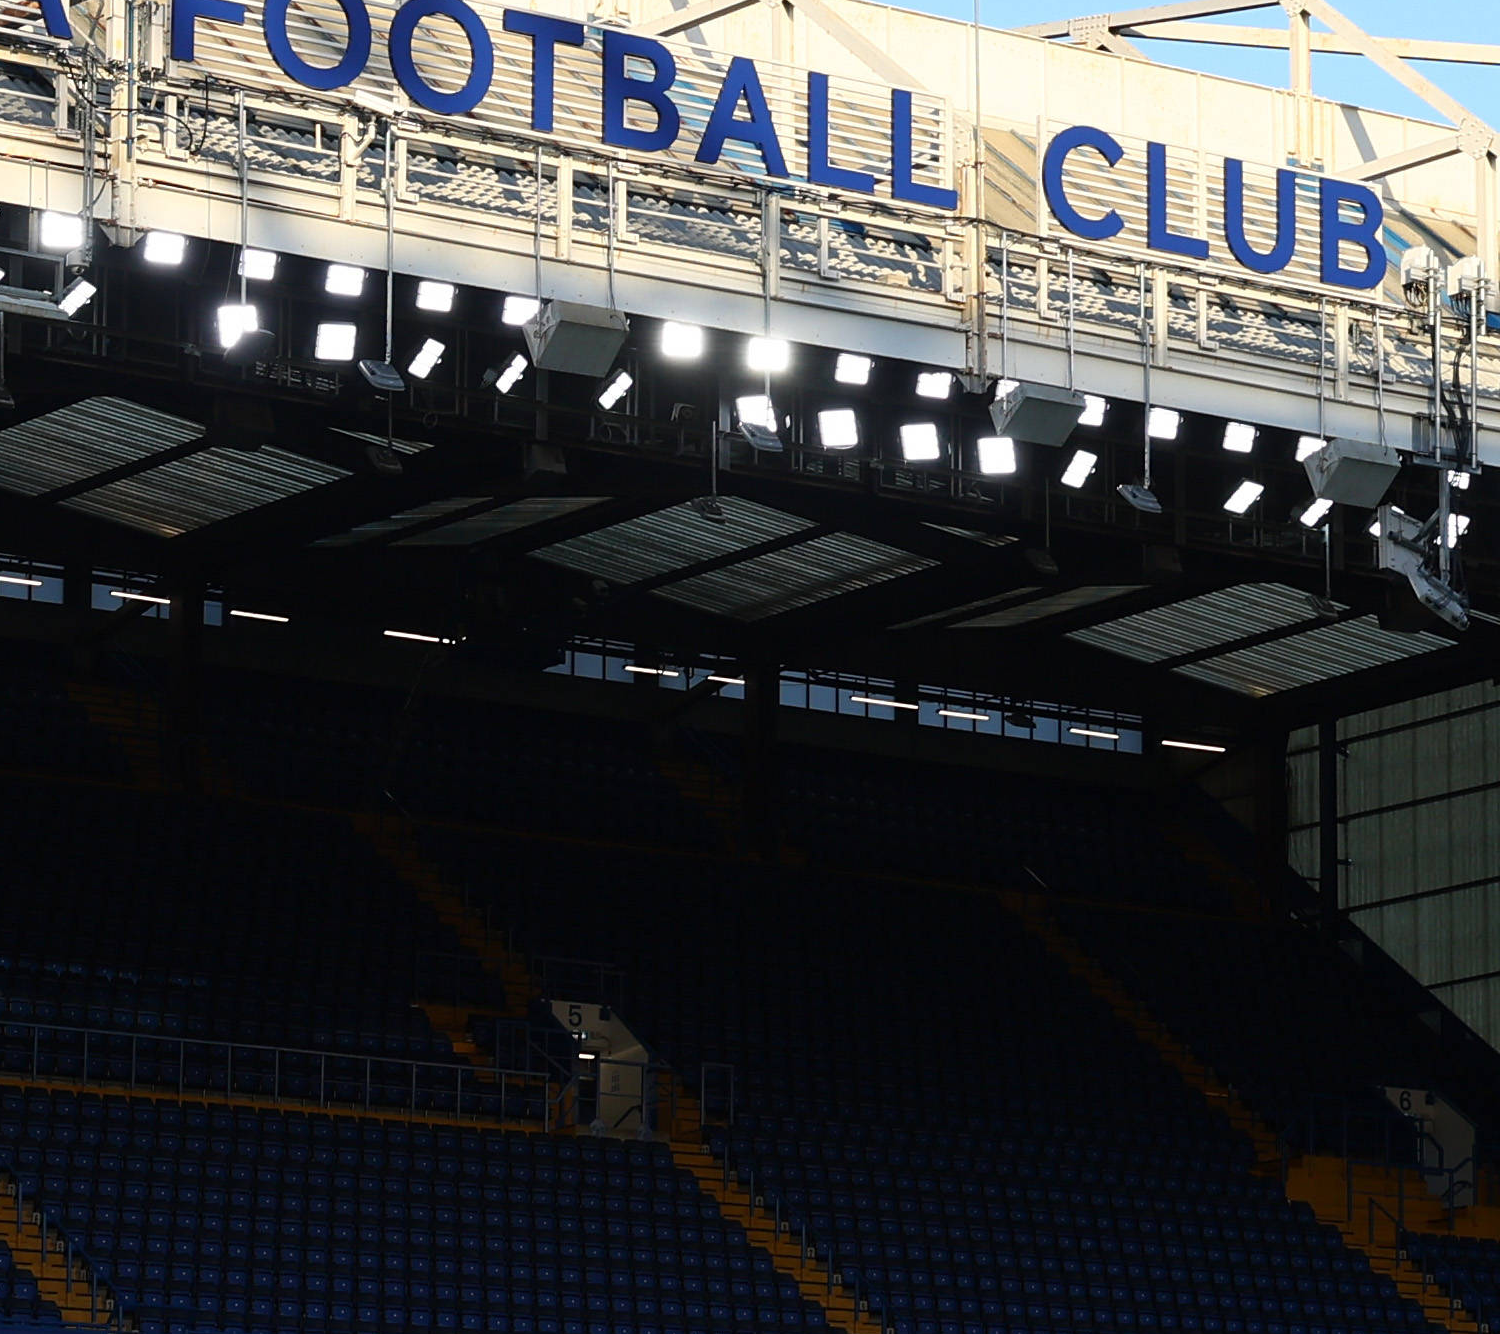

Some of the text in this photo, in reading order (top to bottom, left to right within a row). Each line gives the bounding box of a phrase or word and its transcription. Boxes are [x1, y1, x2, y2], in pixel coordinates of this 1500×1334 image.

[1043, 123, 1388, 289] CLUB
[569, 1005, 582, 1026] 5
[1400, 1091, 1411, 1110] 6
